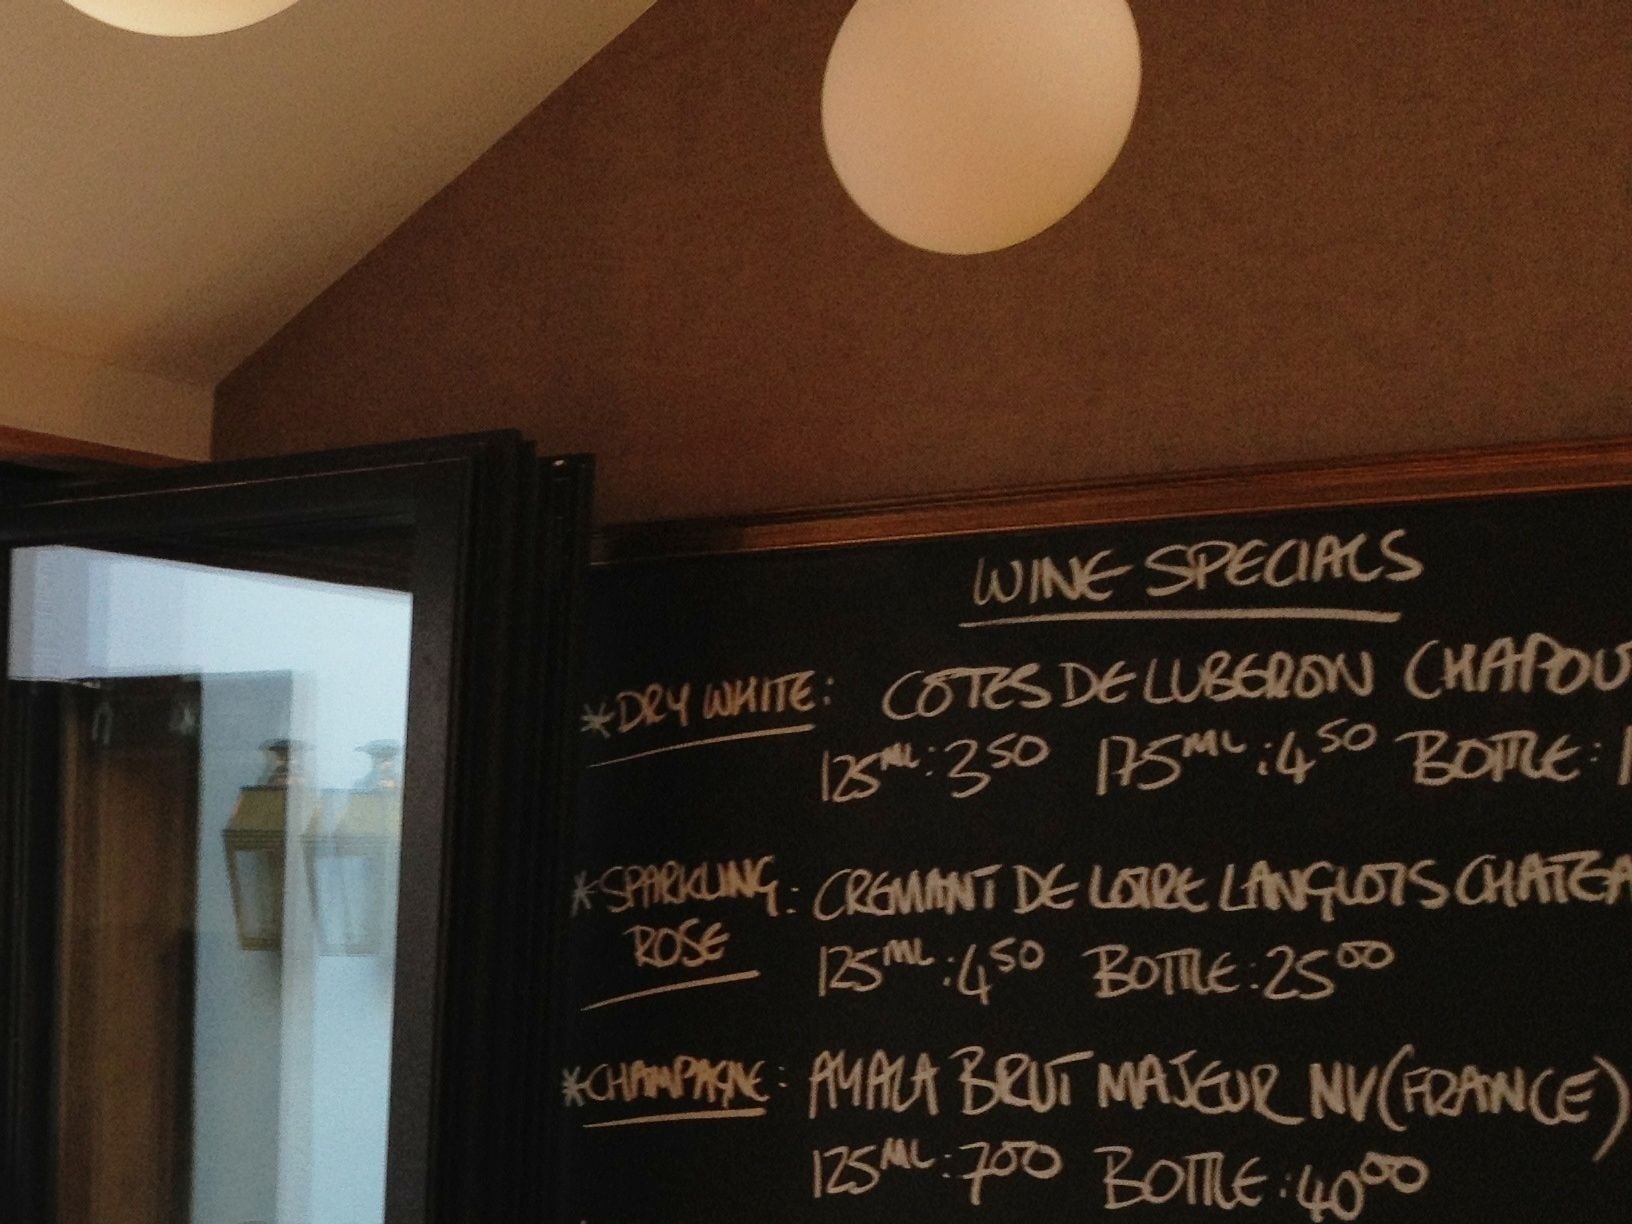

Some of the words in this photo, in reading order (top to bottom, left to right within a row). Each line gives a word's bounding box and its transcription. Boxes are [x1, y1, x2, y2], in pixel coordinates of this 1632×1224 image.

[972, 550, 1134, 606] WINE
[1145, 529, 1424, 597] SPECIALS
[616, 682, 690, 733] DRY
[703, 670, 834, 718] WHITE:
[882, 663, 1052, 721] COTES
[1059, 660, 1137, 707] DE
[1143, 651, 1374, 704] LUBERON
[1404, 632, 1632, 700] CHAPOU
[814, 863, 1002, 920] CREMANT
[1014, 863, 1079, 914] DE
[1089, 862, 1208, 912] LOIRE
[624, 918, 729, 968] ROSE
[810, 1050, 940, 1120] AYALA
[949, 1046, 1094, 1115] BRUT
[1097, 1050, 1304, 1125] MAJEUR
